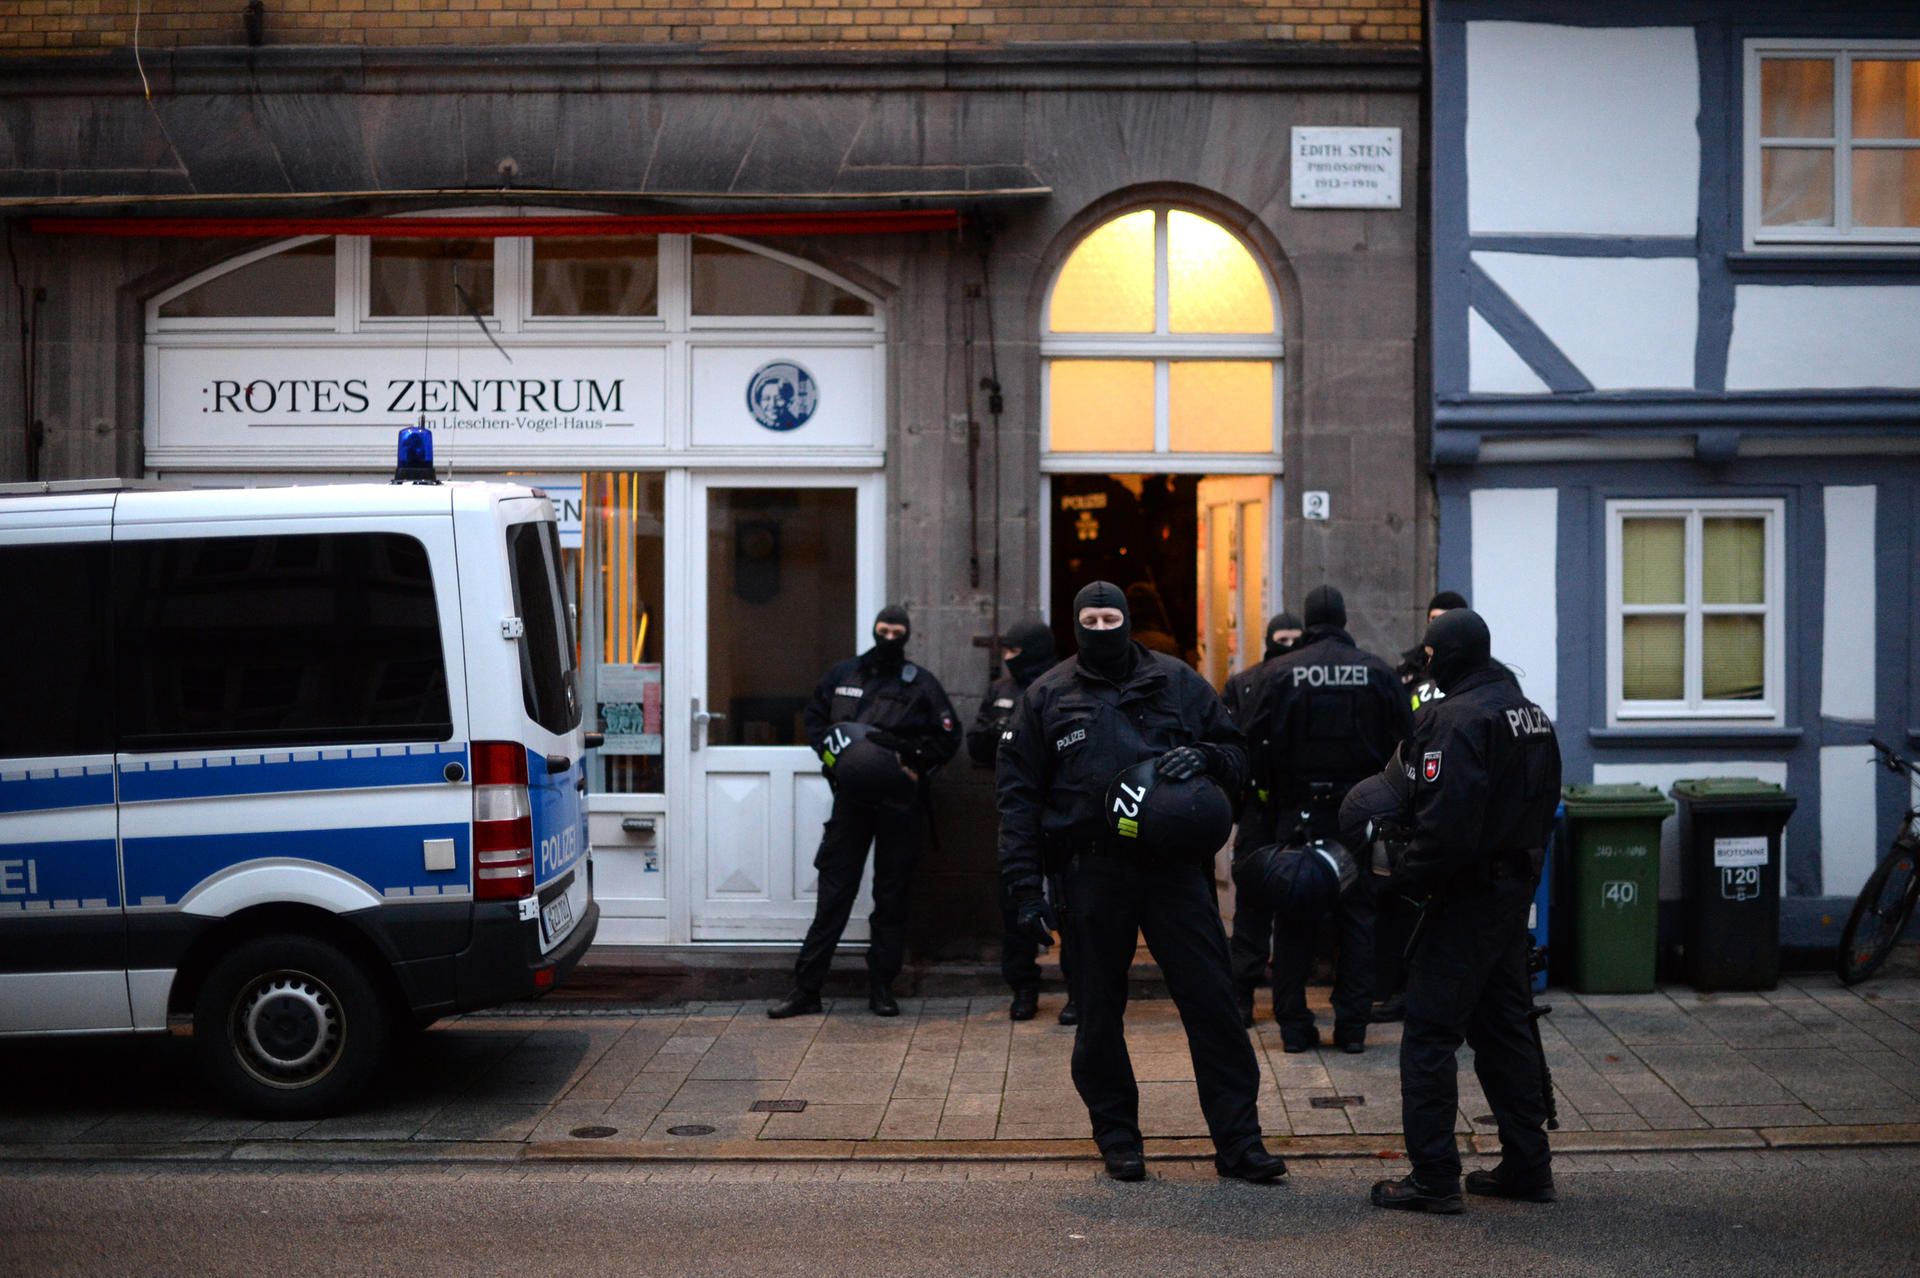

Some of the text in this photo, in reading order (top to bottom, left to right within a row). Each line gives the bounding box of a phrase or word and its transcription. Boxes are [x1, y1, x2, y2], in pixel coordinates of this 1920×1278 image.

[1300, 144, 1392, 157] EDITH STEIN
[387, 379, 625, 413] ZENTRUM
[443, 416, 603, 433] Lieschen-Vogel-Haus
[1293, 665, 1368, 687] POLIZEI
[823, 727, 852, 755] 72
[1056, 728, 1086, 751] POLIZEI
[1113, 782, 1146, 818] 72
[541, 825, 577, 876] POLIZEI
[1725, 868, 1757, 885] 120
[1605, 883, 1634, 902] 40
